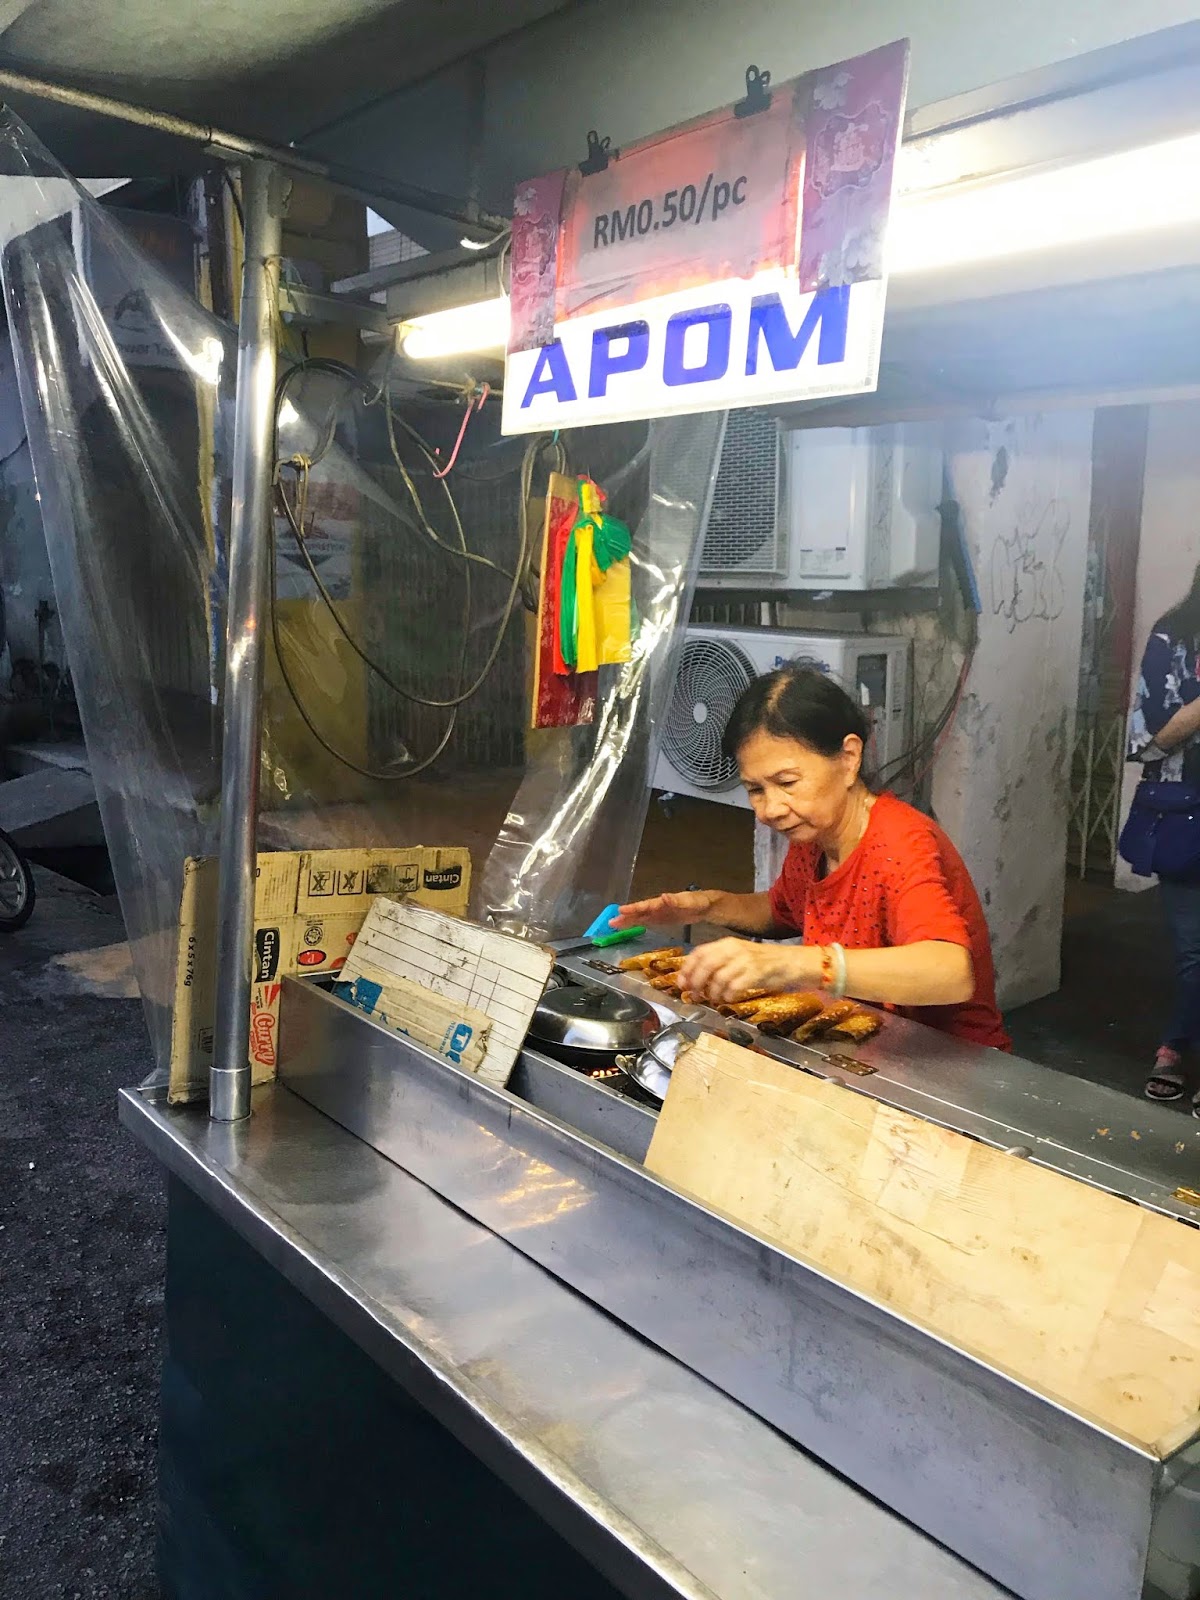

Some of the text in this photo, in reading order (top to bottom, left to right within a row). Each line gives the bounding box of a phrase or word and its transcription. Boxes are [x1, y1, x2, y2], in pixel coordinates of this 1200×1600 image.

[593, 173, 748, 249] RM0.50/pc
[520, 284, 851, 410] APOM
[425, 873, 460, 884] Cintan
[184, 968, 195, 987] 76g
[261, 931, 275, 979] Cintan
[253, 1012, 276, 1066] Curry
